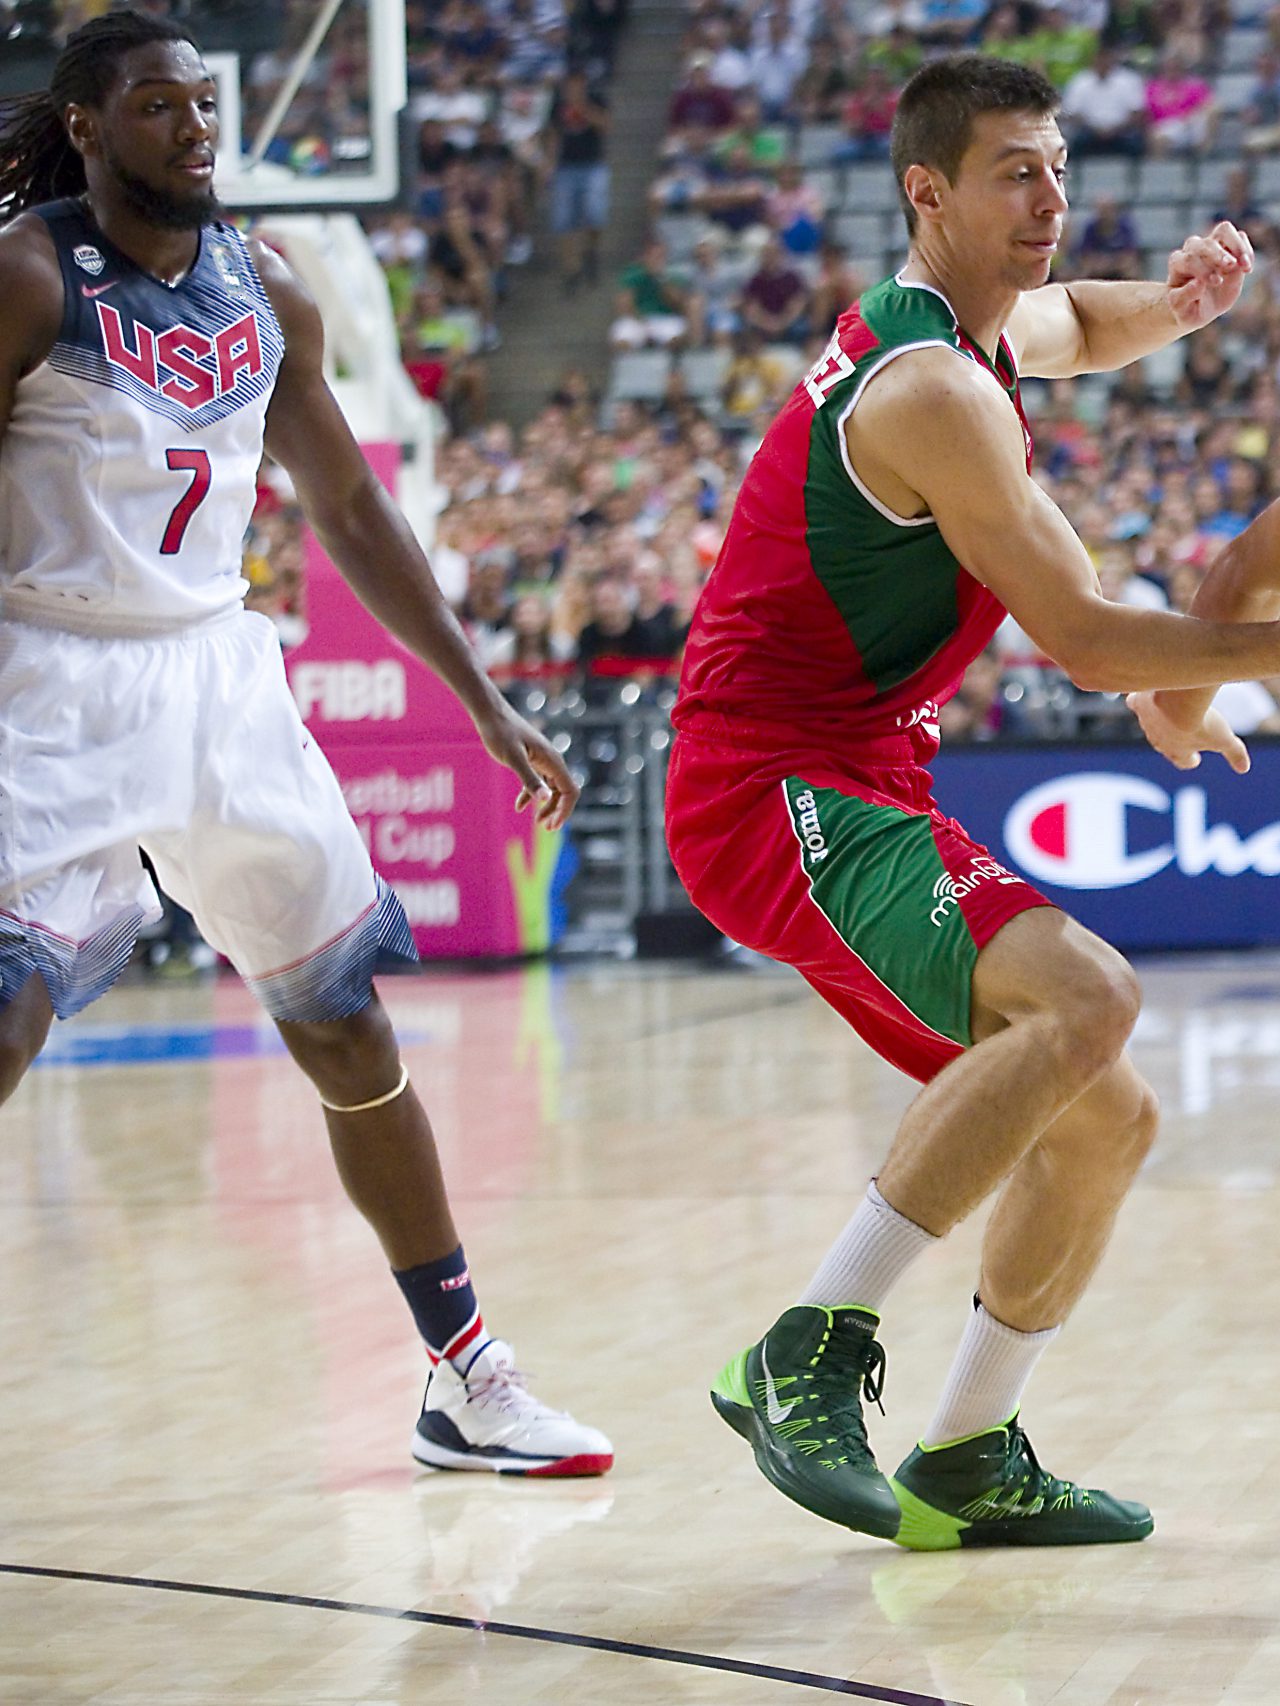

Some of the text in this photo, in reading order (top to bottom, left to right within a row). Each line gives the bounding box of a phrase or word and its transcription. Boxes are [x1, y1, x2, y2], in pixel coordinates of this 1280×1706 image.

[95, 300, 266, 412] USA
[160, 448, 212, 555] 7
[291, 658, 407, 722] FIBA
[341, 766, 455, 817] etball
[375, 814, 457, 869] Cup
